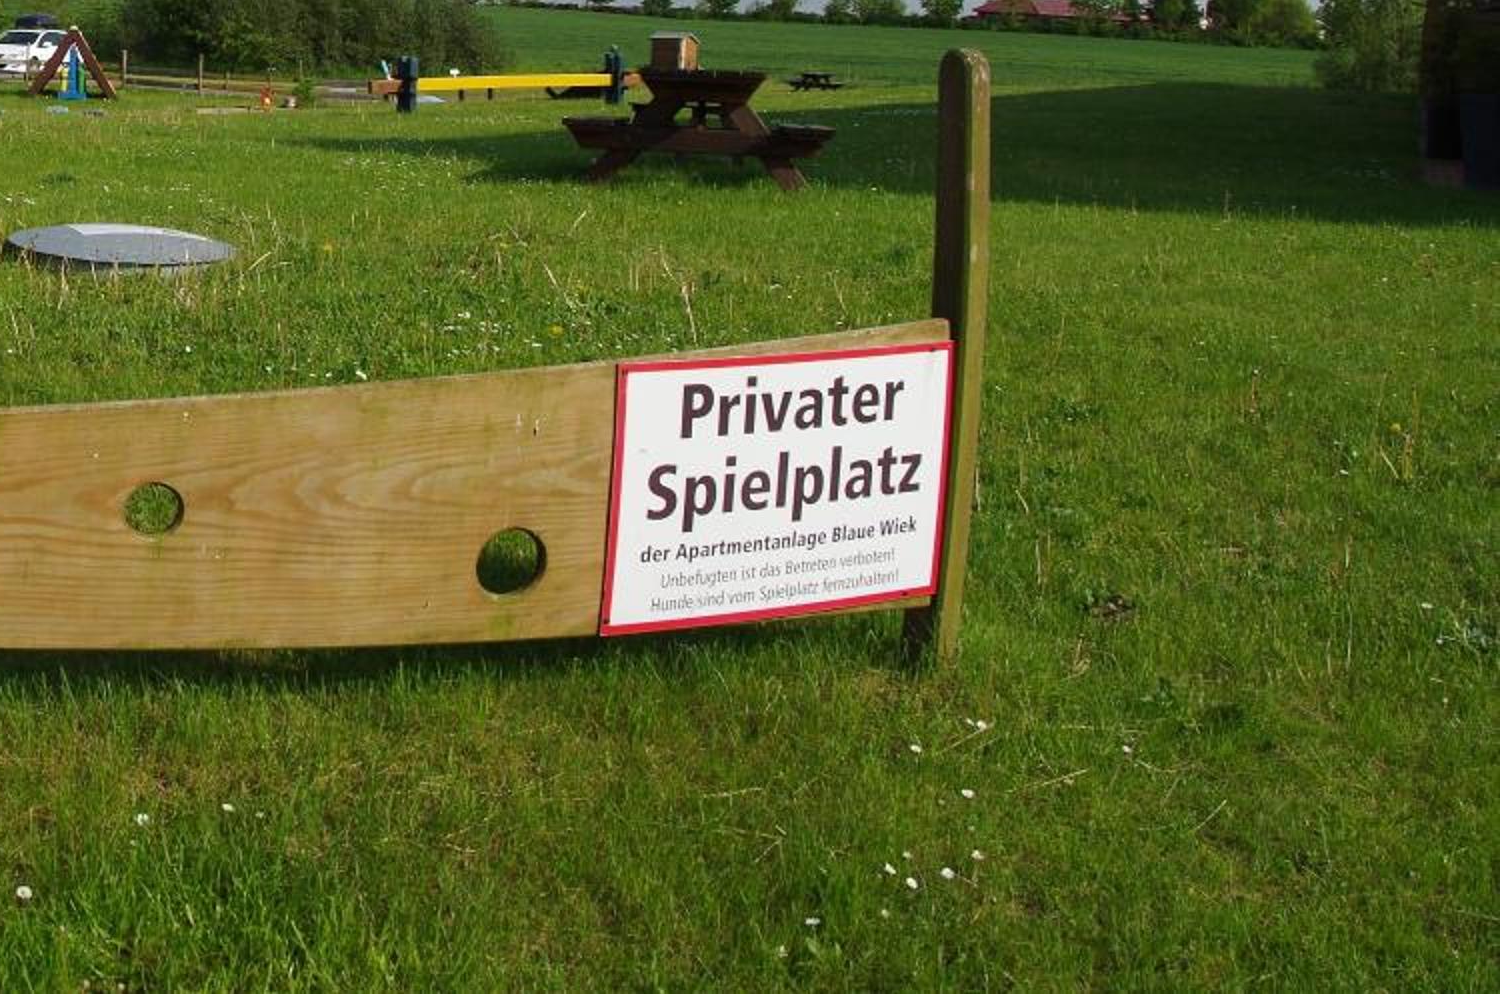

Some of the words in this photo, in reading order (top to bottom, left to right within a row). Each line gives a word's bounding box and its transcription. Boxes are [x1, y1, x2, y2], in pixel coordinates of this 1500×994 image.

[680, 376, 904, 439] Privater
[646, 446, 923, 532] Spielplatz
[640, 546, 670, 563] der
[676, 530, 827, 563] Apartmentanlage
[832, 525, 875, 543] Blaue
[880, 515, 917, 536] Wiek
[651, 594, 693, 611] Hunde
[697, 590, 725, 606] sind
[728, 591, 755, 605] vom
[760, 581, 819, 603] Spielplatz
[823, 568, 899, 593] fernzuhalten!
[660, 569, 737, 588] Unbefugten
[741, 565, 756, 581] ist
[759, 563, 781, 579] das
[785, 557, 837, 575] Betreten
[840, 548, 895, 569] verboten!
